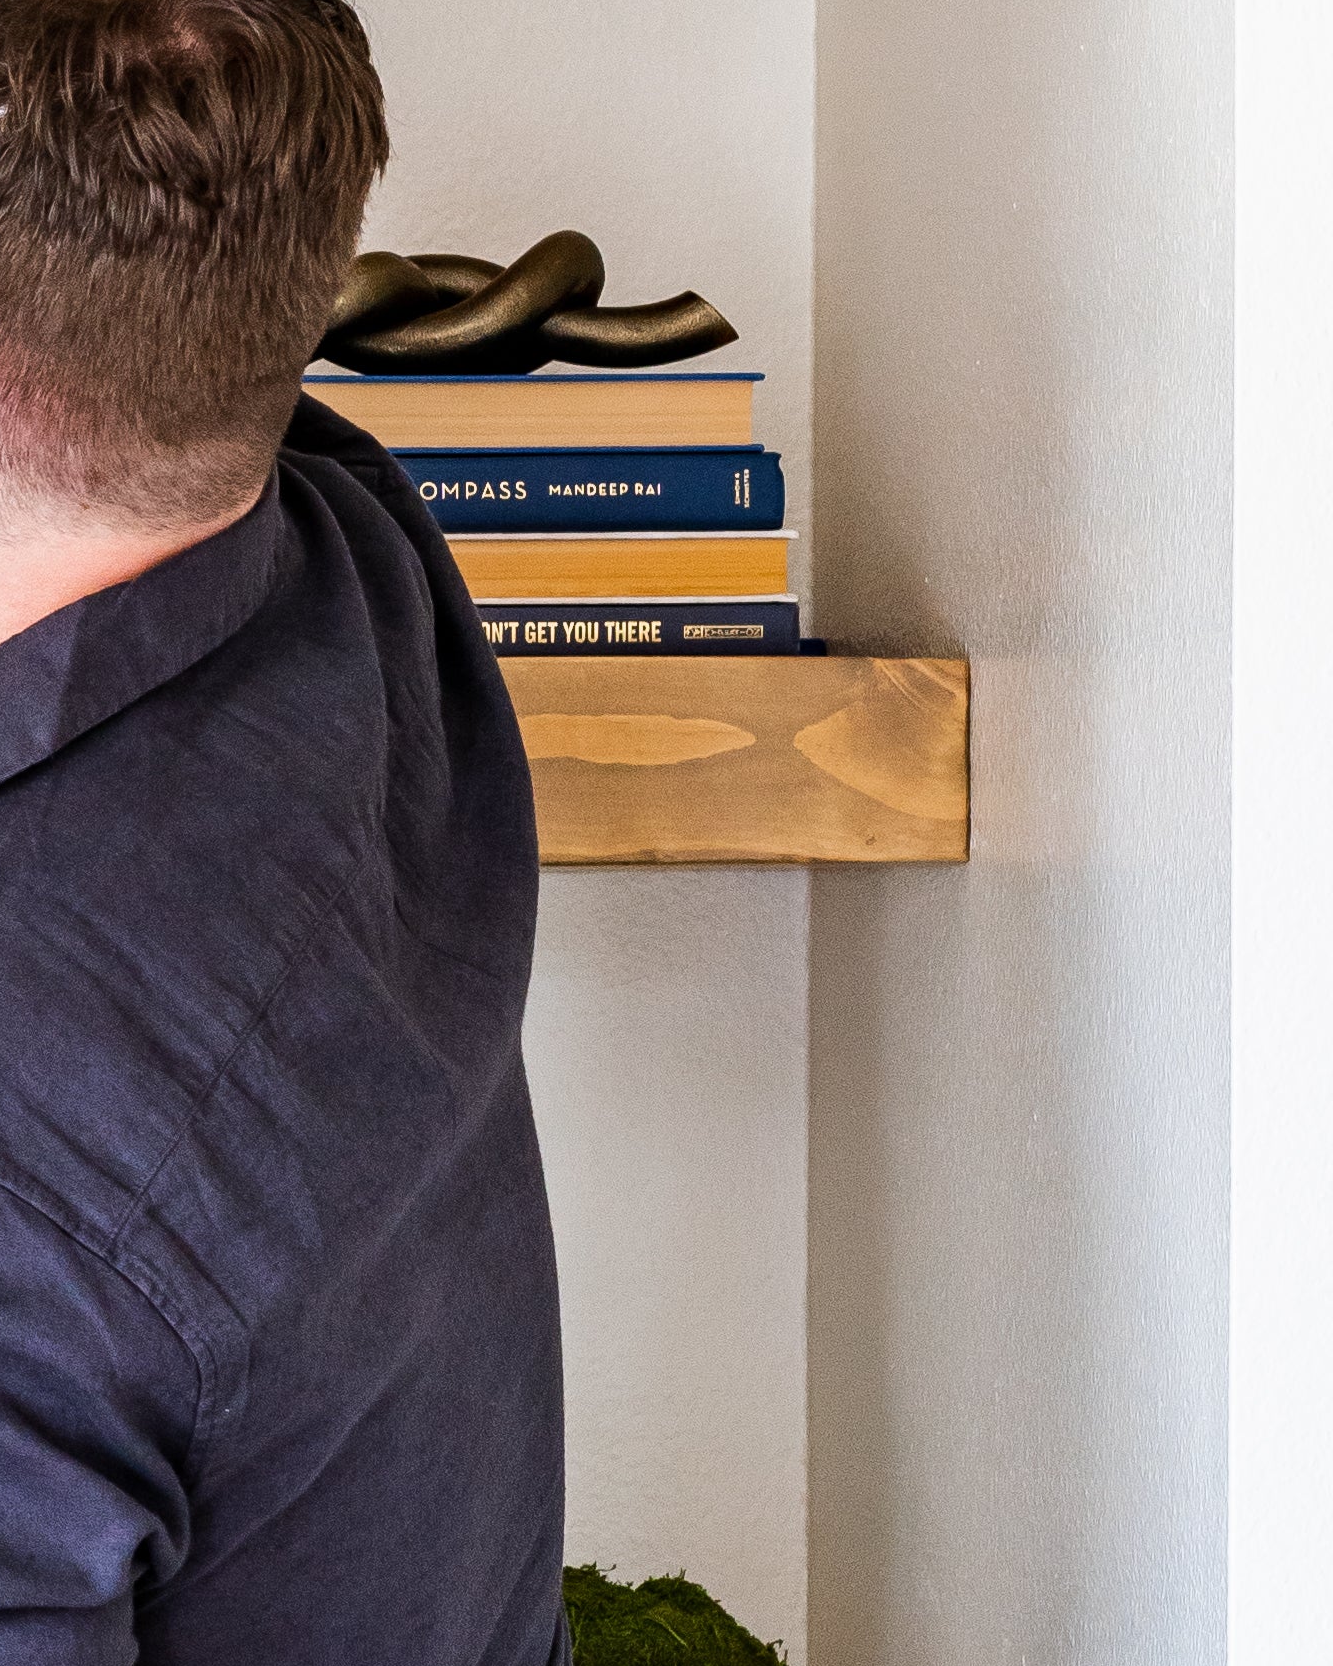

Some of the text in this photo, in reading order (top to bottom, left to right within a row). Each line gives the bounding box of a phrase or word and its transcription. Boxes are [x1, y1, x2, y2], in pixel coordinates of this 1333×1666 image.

[420, 481, 661, 500] OMPASS MANDEEP RAI
[482, 620, 662, 644] N'T GET YOU THERE
